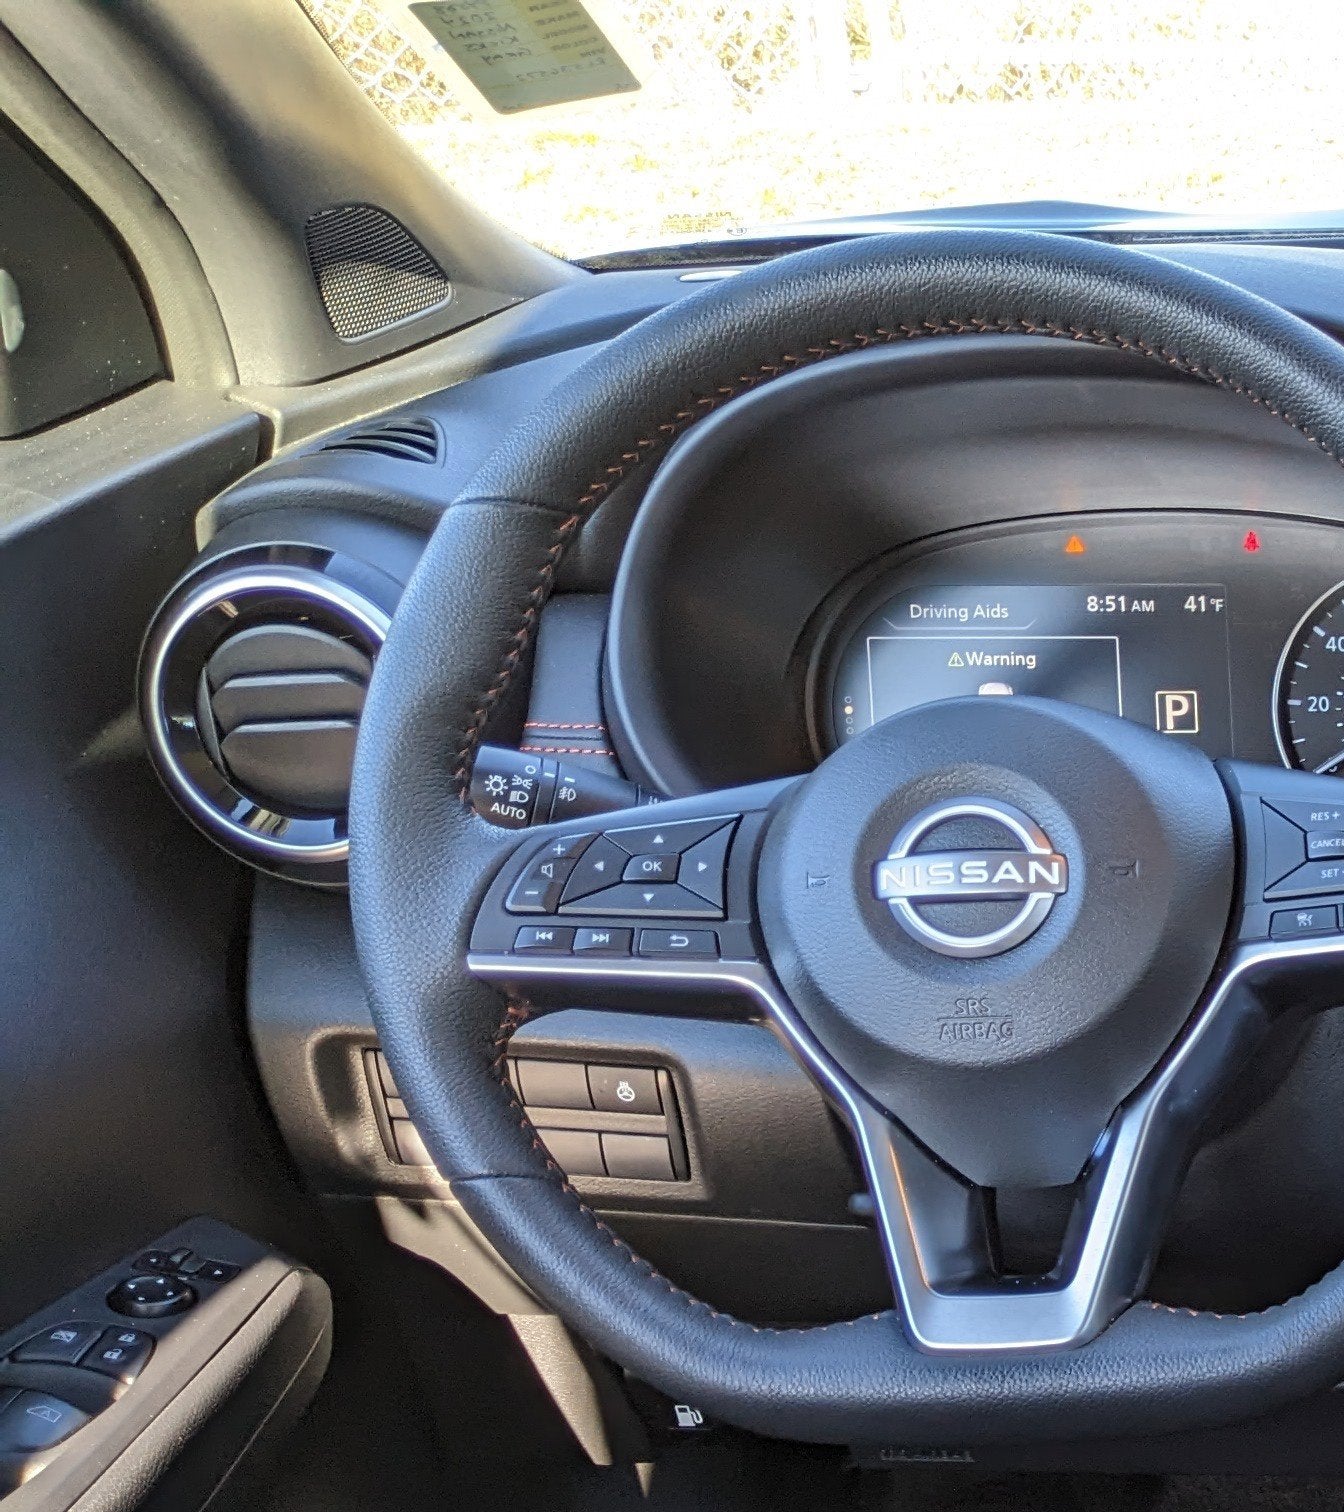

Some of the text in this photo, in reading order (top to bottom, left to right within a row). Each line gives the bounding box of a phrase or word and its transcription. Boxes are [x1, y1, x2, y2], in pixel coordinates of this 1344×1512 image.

[1087, 595, 1126, 612] 8:51
[1131, 600, 1155, 612] AM
[910, 604, 1009, 621] Driving Aids
[966, 652, 1037, 669] Warning
[1165, 694, 1189, 730] P
[1307, 696, 1330, 712] 20
[490, 802, 527, 820] AUTO
[1311, 812, 1330, 821] RES
[642, 861, 662, 872] OK
[880, 860, 1060, 890] NISSAN
[1321, 868, 1339, 879] SET
[954, 997, 992, 1016] SRS
[939, 1020, 1014, 1041] AIRBAG
